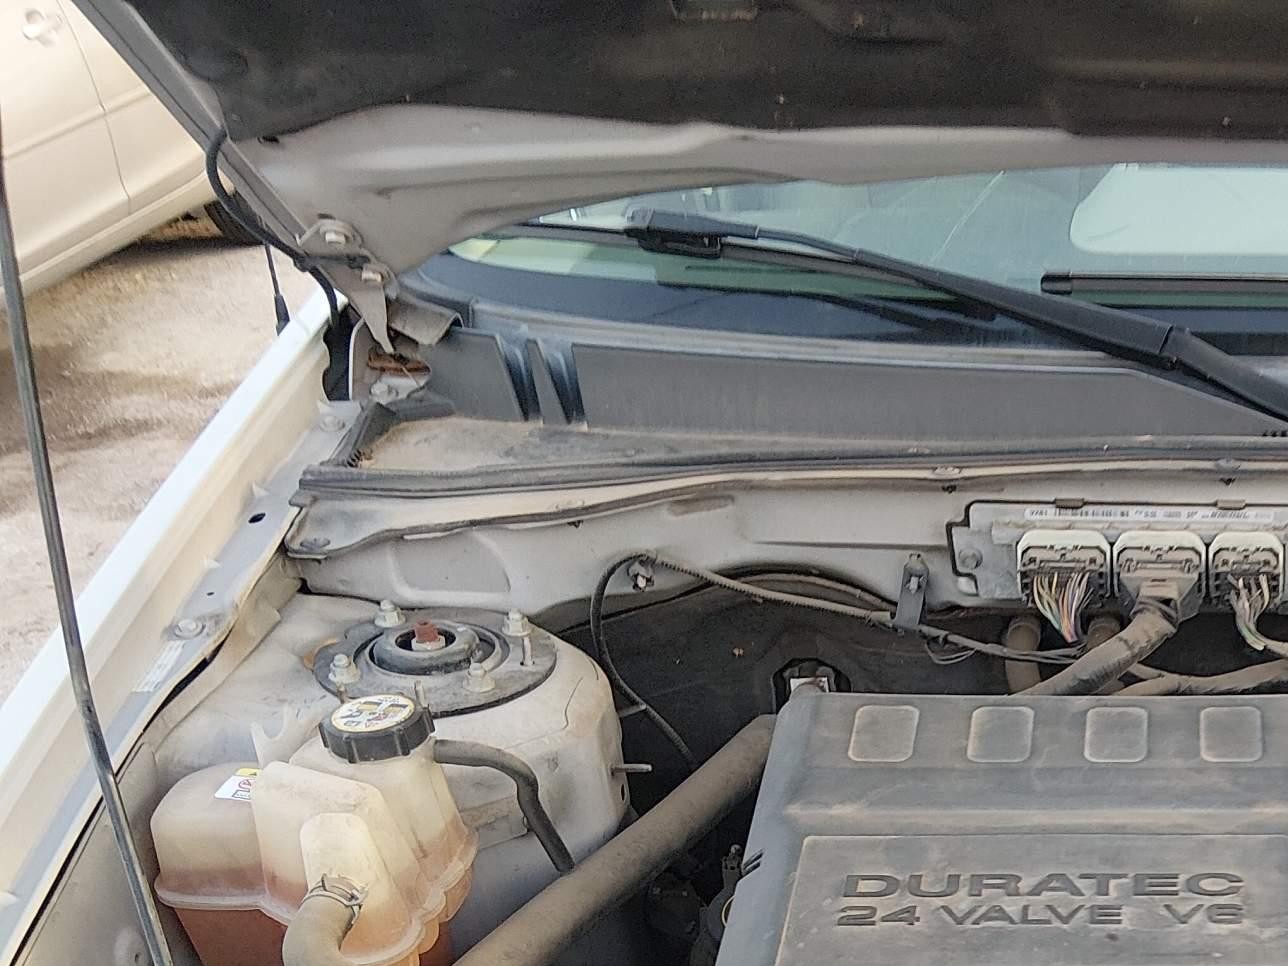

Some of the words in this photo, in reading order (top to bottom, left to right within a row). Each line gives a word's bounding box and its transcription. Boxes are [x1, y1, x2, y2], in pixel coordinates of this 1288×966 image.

[842, 872, 1244, 898] DURATEC
[836, 904, 921, 926] 24
[938, 904, 1124, 926] VALVE
[1163, 903, 1244, 925] V6
